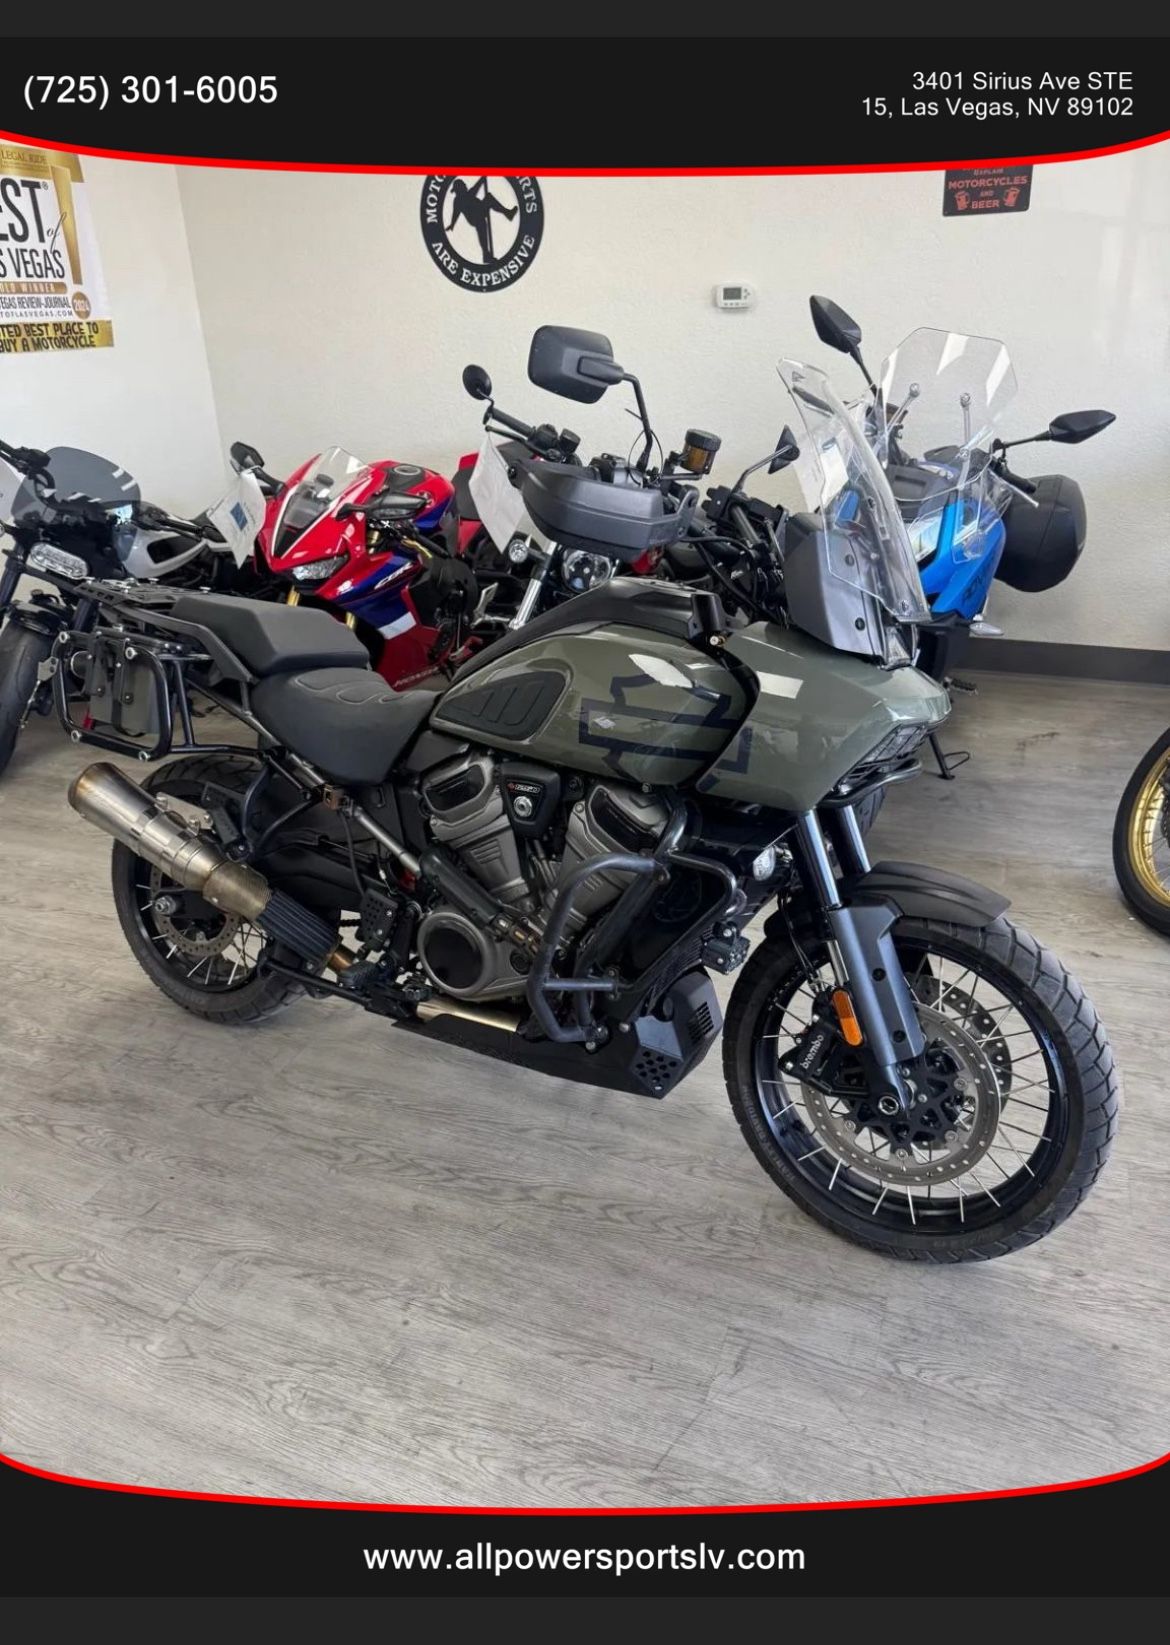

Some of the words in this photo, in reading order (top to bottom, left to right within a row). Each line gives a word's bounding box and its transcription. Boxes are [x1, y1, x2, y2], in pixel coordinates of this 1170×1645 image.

[948, 176, 1028, 190] MOTORCYCLES
[971, 200, 999, 209] BEER
[7, 249, 65, 279] VEGAS
[432, 242, 458, 275] ARE
[460, 234, 535, 287] EXPENSIVE
[17, 295, 72, 309] REVIEW-JOURNAL
[23, 323, 49, 337] BEST
[53, 322, 84, 336] PLACE
[86, 322, 99, 334] TO
[22, 338, 30, 352] A
[32, 335, 96, 351] MOTORCYCLE
[800, 1035, 824, 1069] brembo
